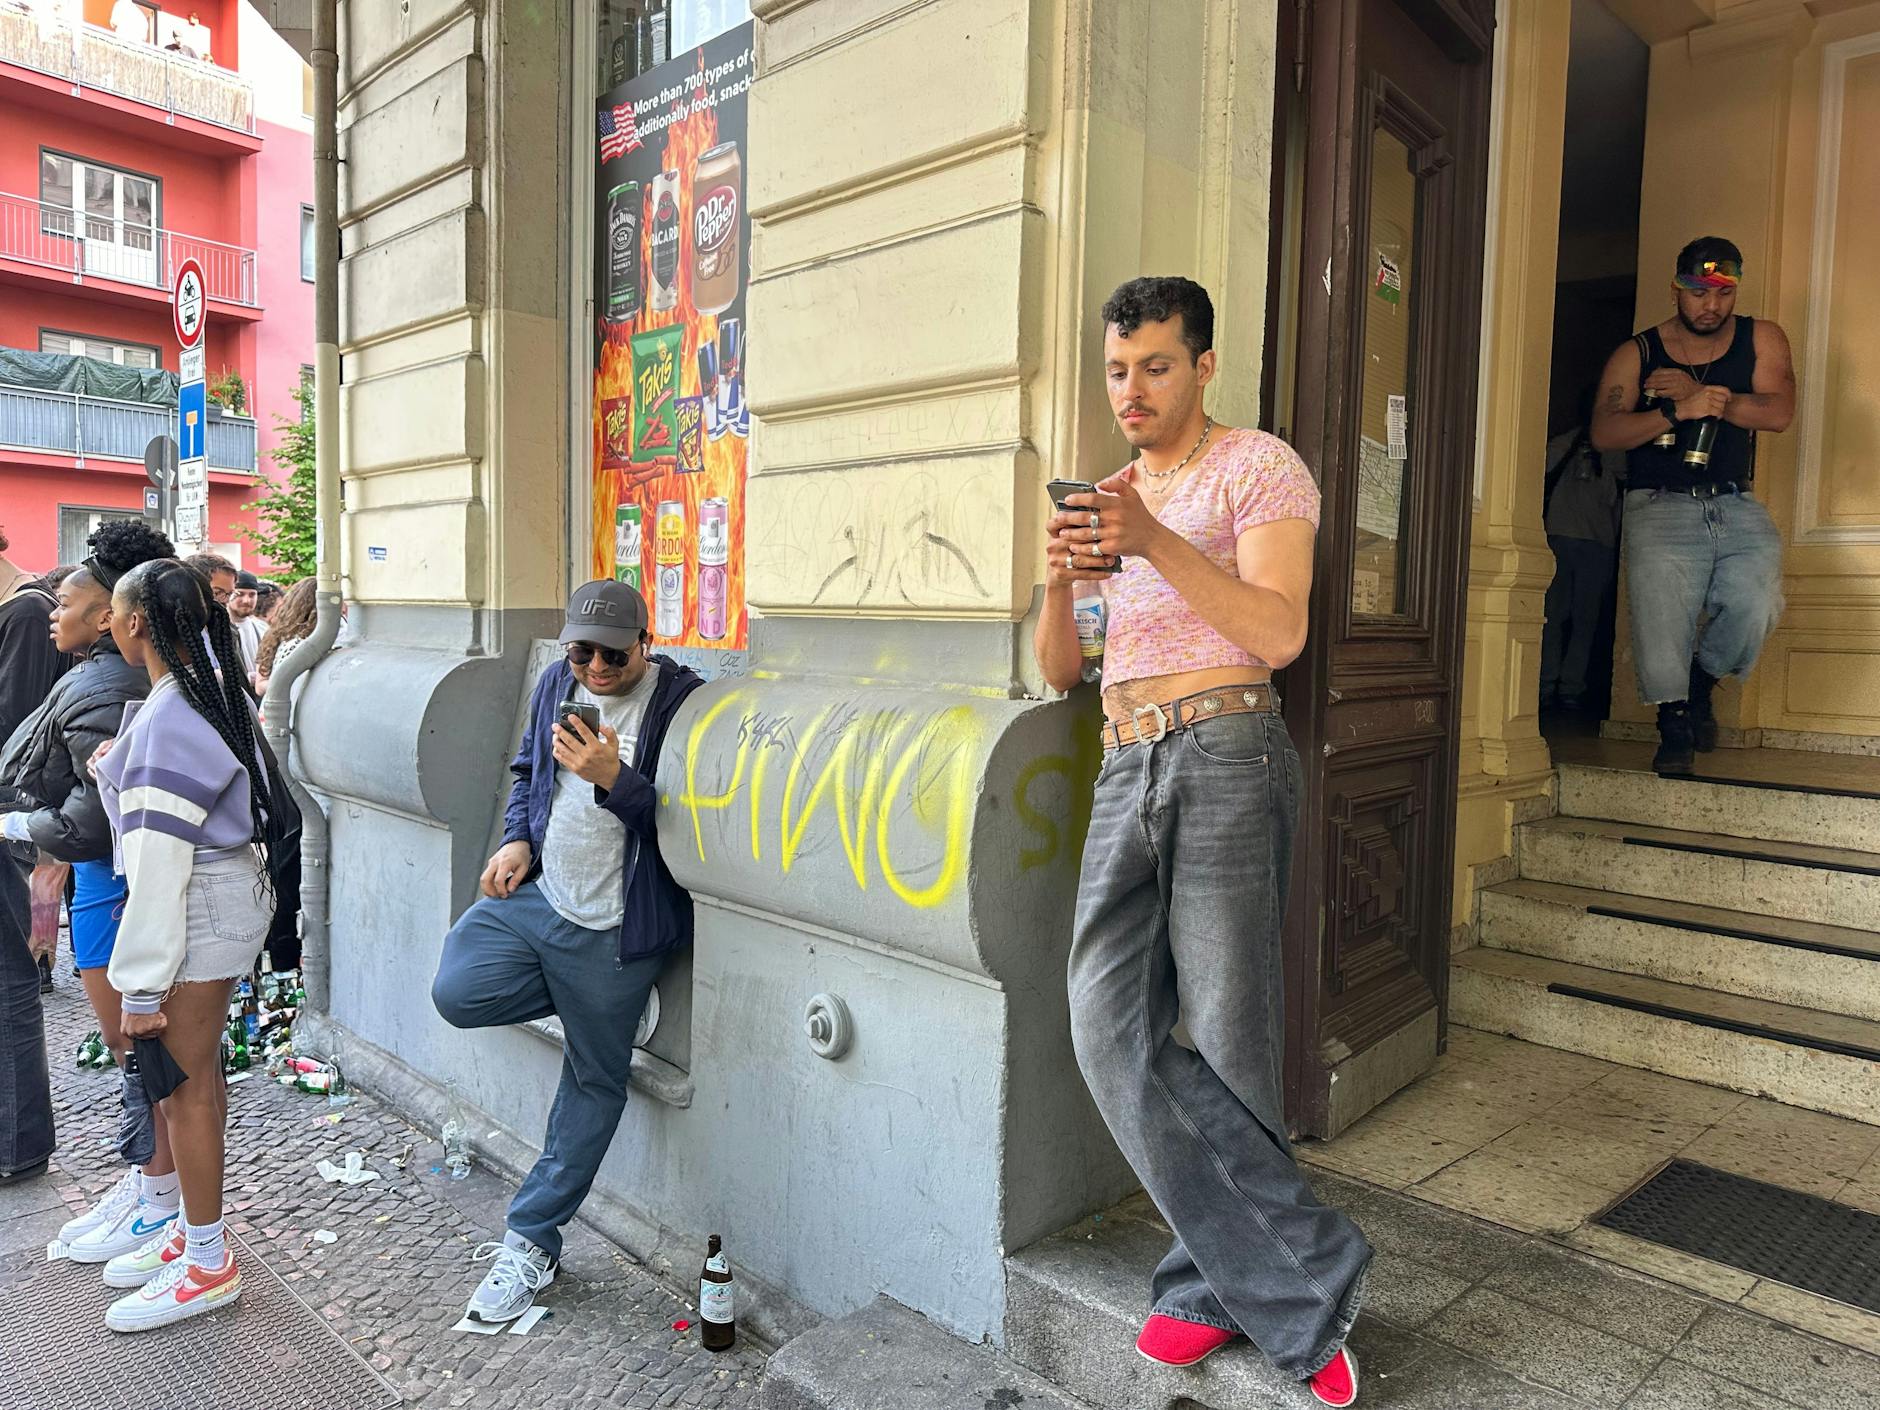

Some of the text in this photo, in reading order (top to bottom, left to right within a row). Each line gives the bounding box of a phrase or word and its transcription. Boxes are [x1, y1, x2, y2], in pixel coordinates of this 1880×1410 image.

[633, 96, 658, 117] More
[660, 85, 682, 105] than
[684, 71, 703, 93] 700
[704, 61, 735, 84] types
[736, 48, 749, 69] of
[633, 103, 689, 140] additionally
[691, 92, 719, 115] food,
[695, 198, 734, 247] Pepper
[708, 193, 725, 222] Dr
[581, 599, 618, 617] UFC
